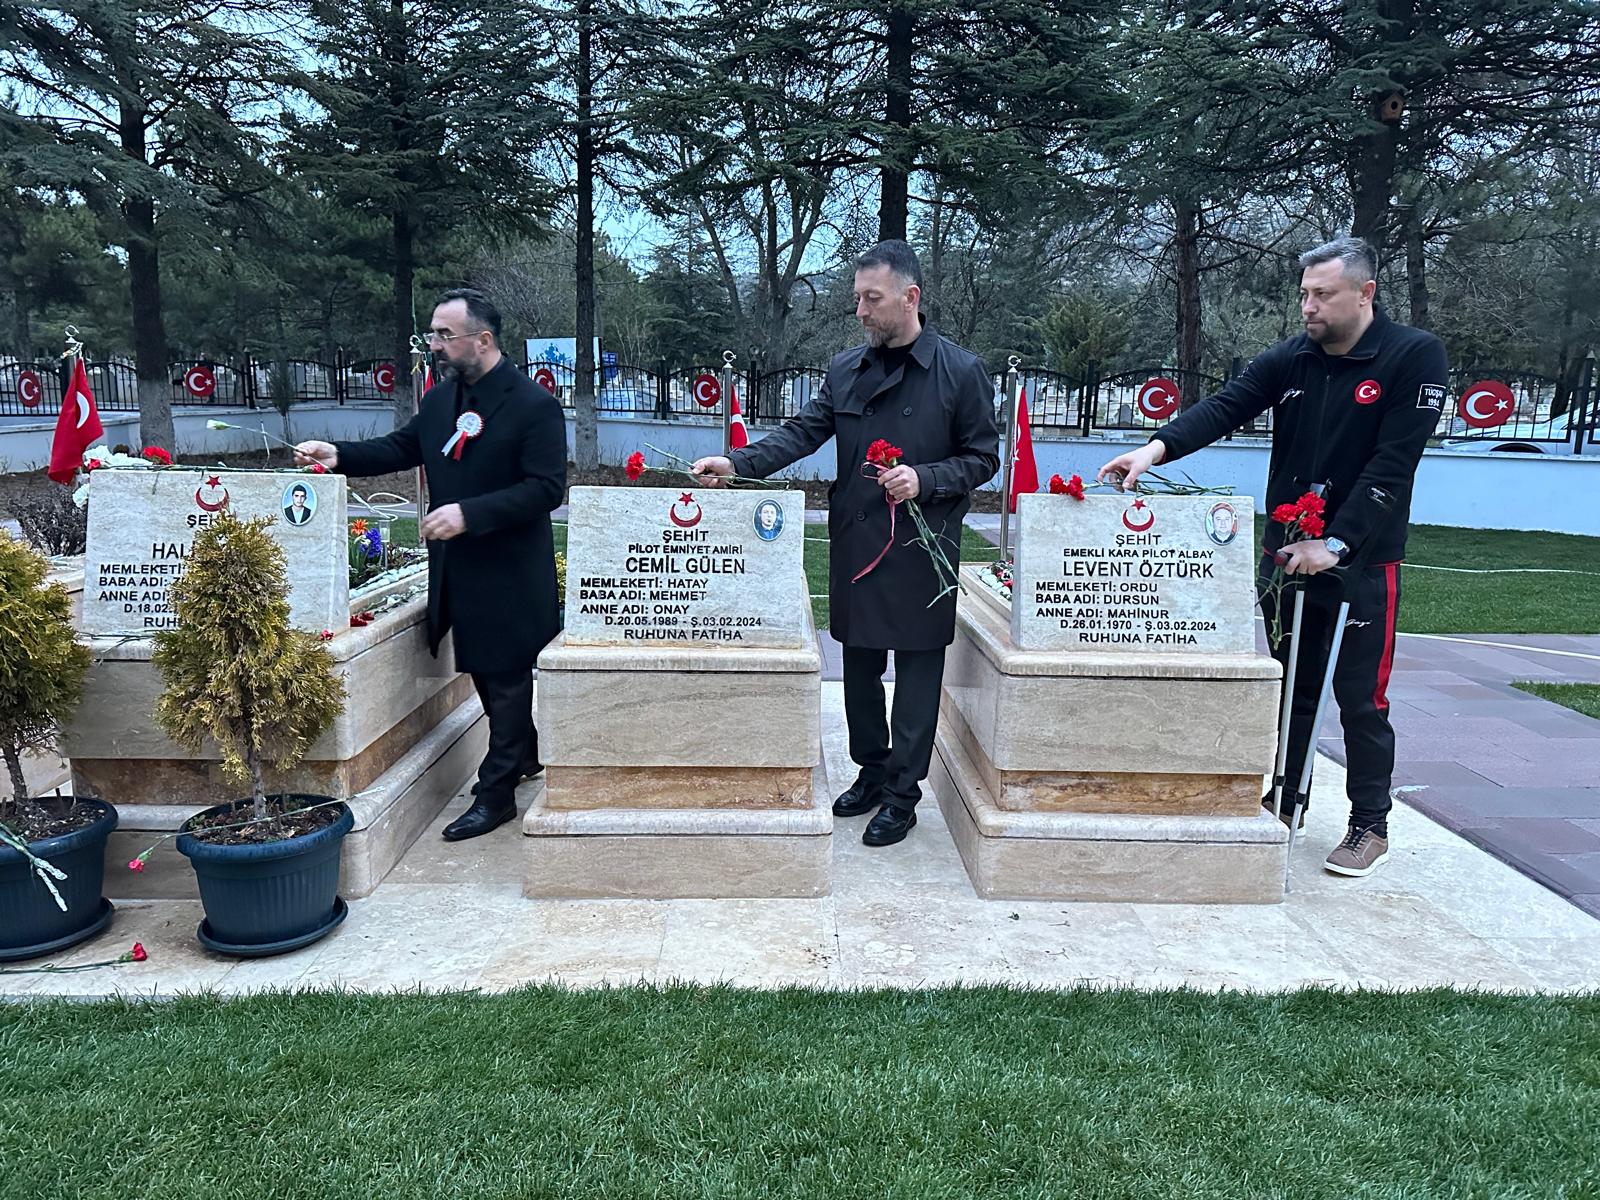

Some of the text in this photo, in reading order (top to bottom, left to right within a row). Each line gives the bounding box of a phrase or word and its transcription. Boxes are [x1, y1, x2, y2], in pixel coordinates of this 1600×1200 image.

[662, 528, 709, 543] ŞEHİT
[1115, 533, 1162, 547] ŞEHİT
[628, 543, 743, 555] PİLOT EMNİYET AMİRİ
[1063, 548, 1214, 559] EMEKLİ KARA PİLOT ALBAY
[625, 555, 745, 574] CEMİL GÜLEN
[1063, 559, 1214, 578] LEVENT ÖZTÜRK
[99, 576, 138, 587] BABA
[140, 577, 168, 587] ADI:
[580, 576, 709, 589] MEMLEKETİ: HATAY
[1036, 581, 1158, 592] MEMLEKETİ: ORDU
[99, 590, 138, 602] ANNE
[580, 590, 707, 601] BABA ADI: MEHMET
[1036, 594, 1159, 605] BABA ADI: DURSUN
[580, 604, 690, 614] ANNE ADI: ONAY
[1036, 608, 1169, 619] ANNE ADI: MAHİNUR
[605, 616, 678, 626] D.20.05.1989
[691, 617, 762, 628] Ş.03.02.2024
[1060, 620, 1132, 630] D.26.01.1970
[1145, 621, 1217, 632] Ş.03.02.2024
[624, 628, 743, 641] RUHUNA FATİHA
[1079, 632, 1198, 644] RUHUNA FATİHA
